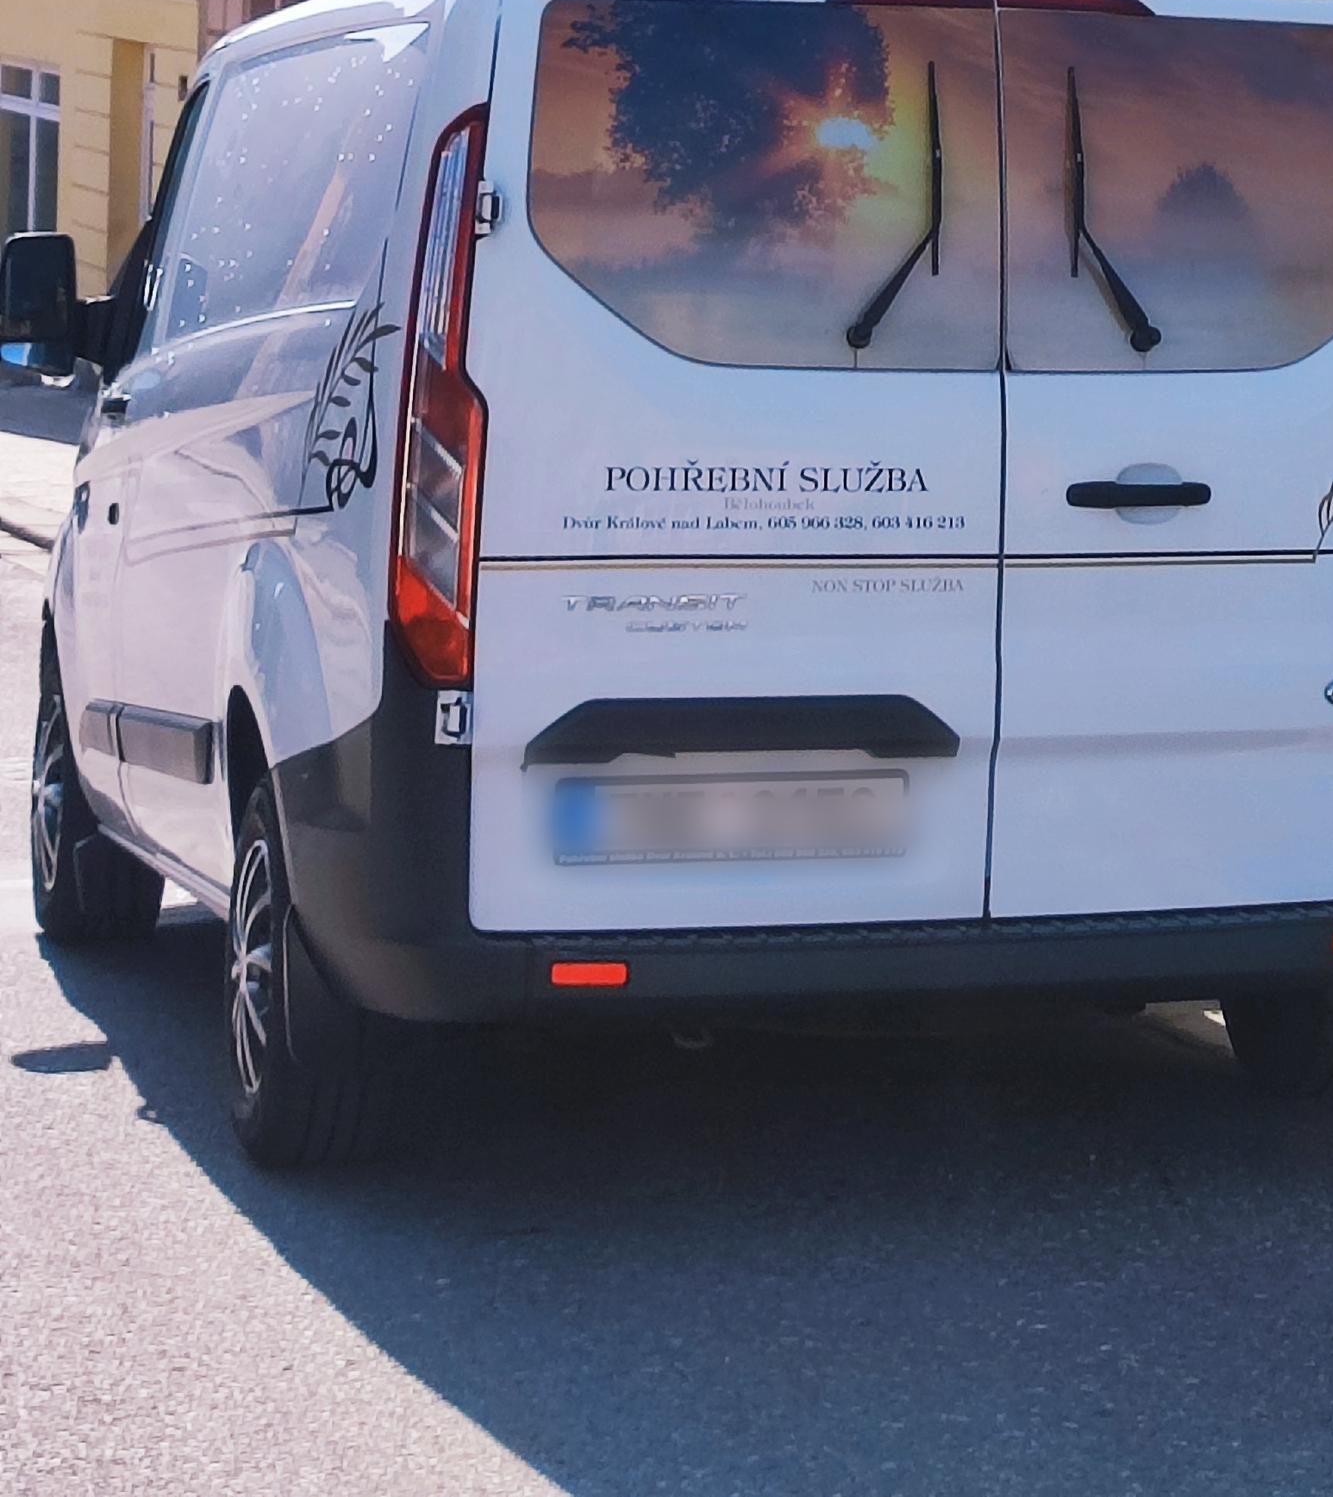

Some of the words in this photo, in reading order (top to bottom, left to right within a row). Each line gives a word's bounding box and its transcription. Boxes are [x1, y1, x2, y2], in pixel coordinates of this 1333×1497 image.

[605, 459, 791, 493] POHŘEBNÍ
[799, 459, 930, 494] SLUŽBA
[606, 514, 667, 530] Králové
[671, 515, 700, 530] nad
[705, 515, 763, 533] Labem,
[767, 515, 797, 530] 605
[801, 515, 830, 530] 966
[834, 515, 868, 533] 328,
[871, 515, 901, 530] 603
[904, 515, 933, 530] 416
[937, 515, 966, 530] 213
[812, 578, 849, 593] NON
[852, 578, 897, 593] STOP
[560, 592, 748, 612] TRANSIT
